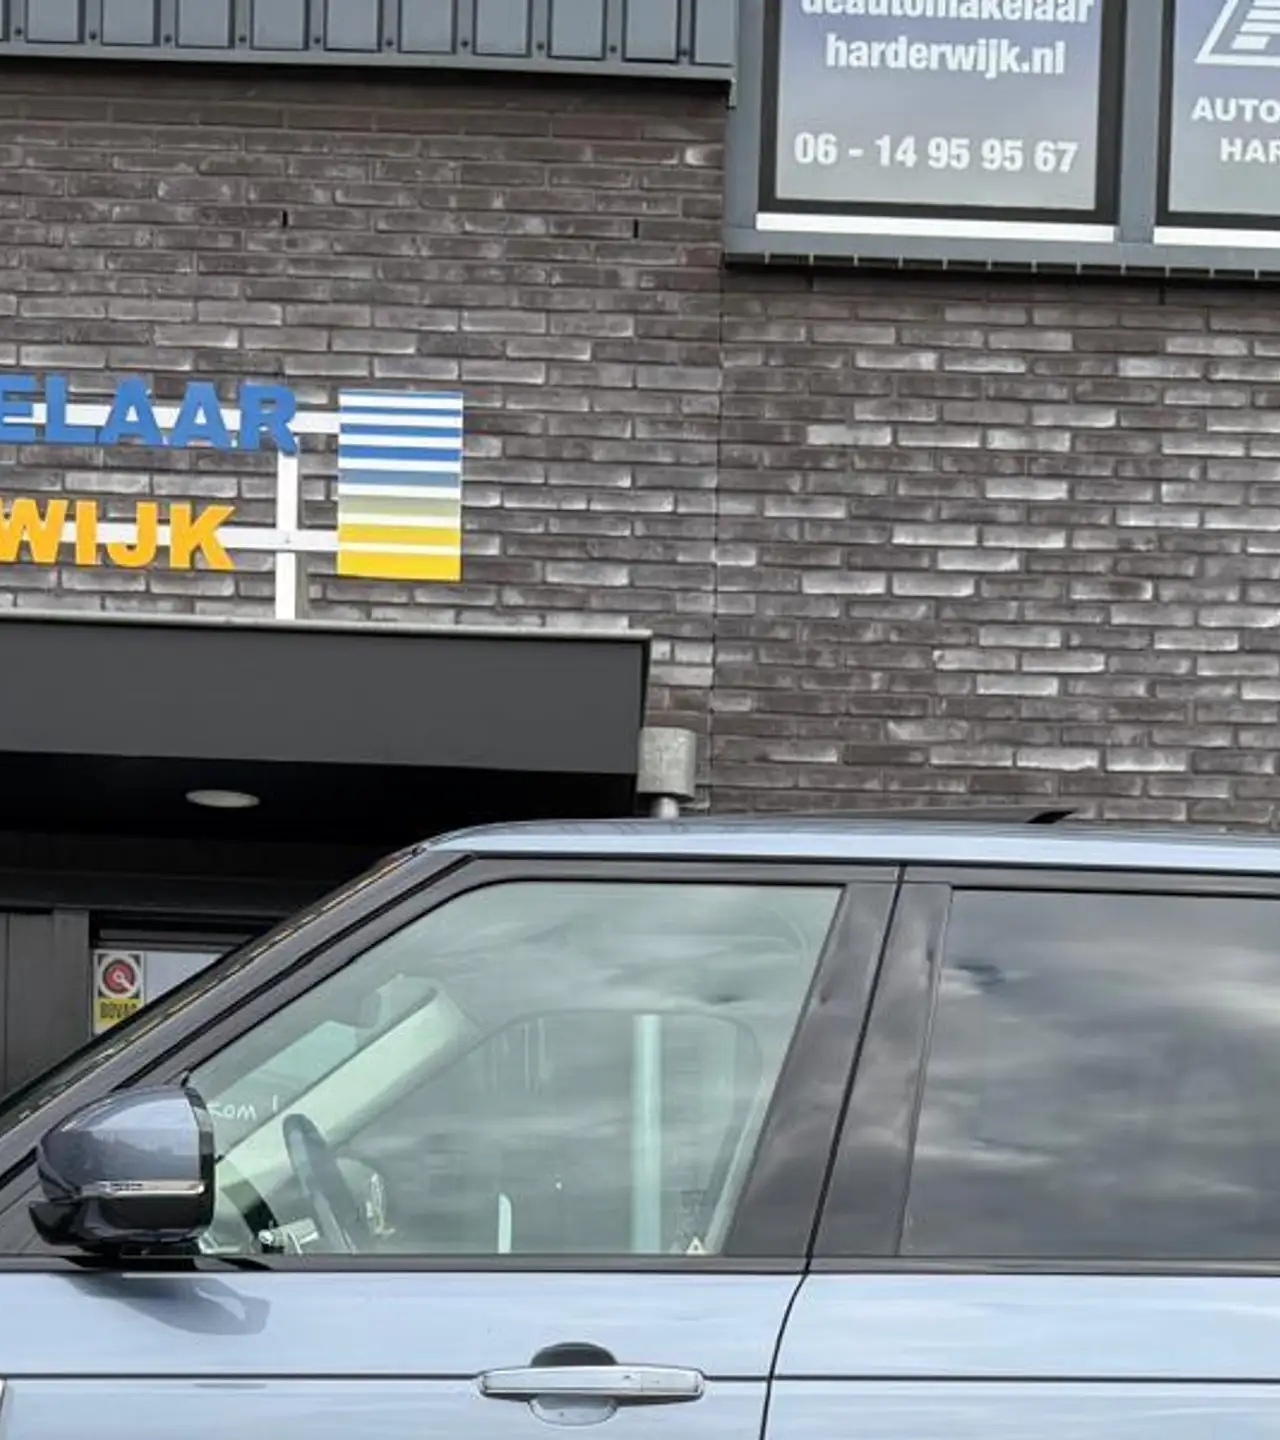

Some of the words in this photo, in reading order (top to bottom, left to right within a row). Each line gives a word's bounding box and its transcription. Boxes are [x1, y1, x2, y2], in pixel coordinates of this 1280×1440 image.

[825, 32, 1067, 80] harderwijk.nl
[794, 131, 839, 165] 06
[874, 134, 919, 168] 14
[926, 136, 971, 170] 95
[980, 138, 1024, 172] 95
[1033, 140, 1080, 173] 67
